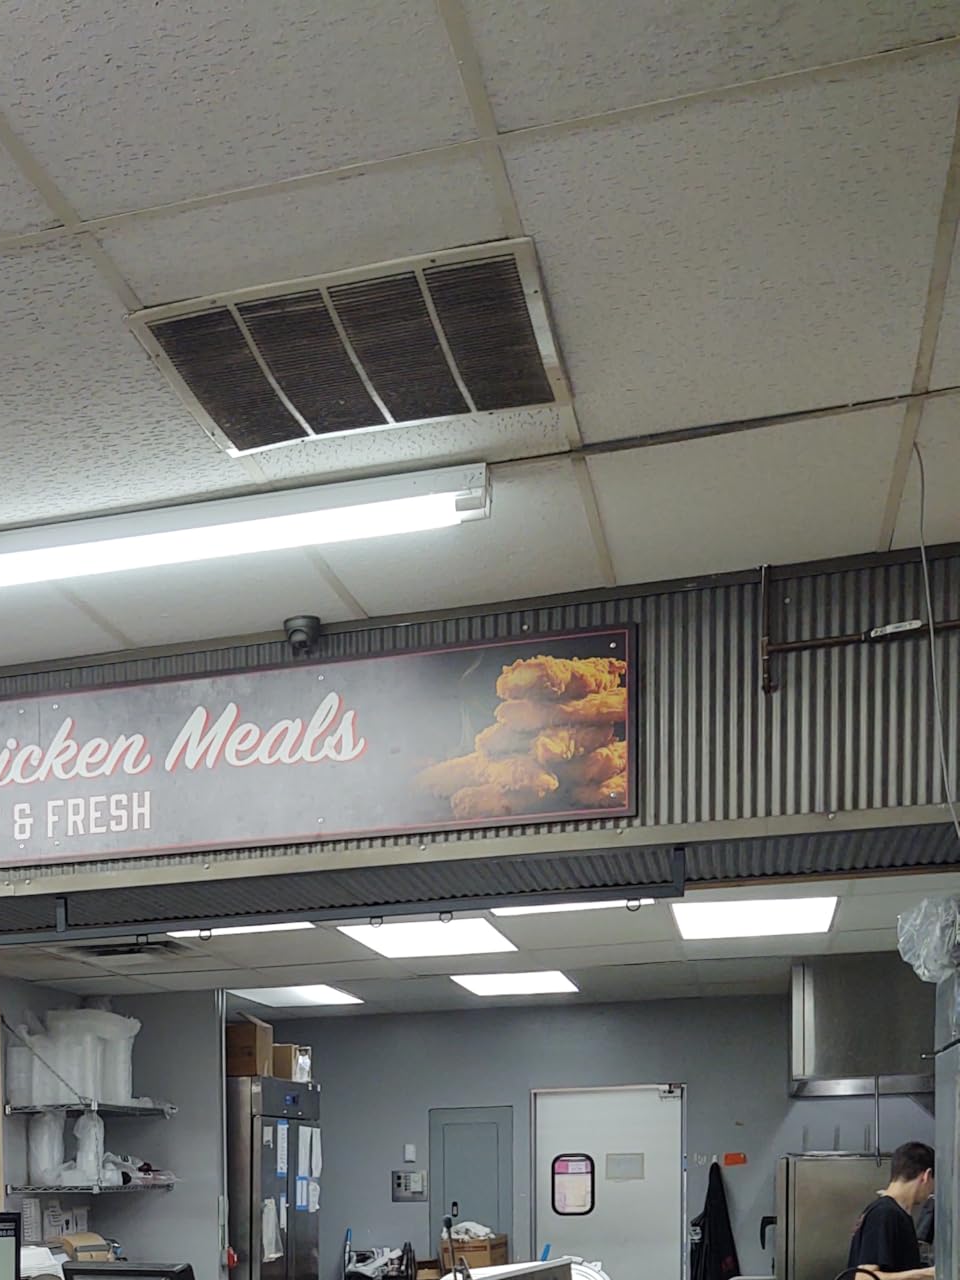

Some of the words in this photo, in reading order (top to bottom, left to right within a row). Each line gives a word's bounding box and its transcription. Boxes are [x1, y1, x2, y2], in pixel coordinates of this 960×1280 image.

[164, 691, 368, 772] Meals
[13, 803, 34, 841] &
[46, 791, 152, 838] FRESH
